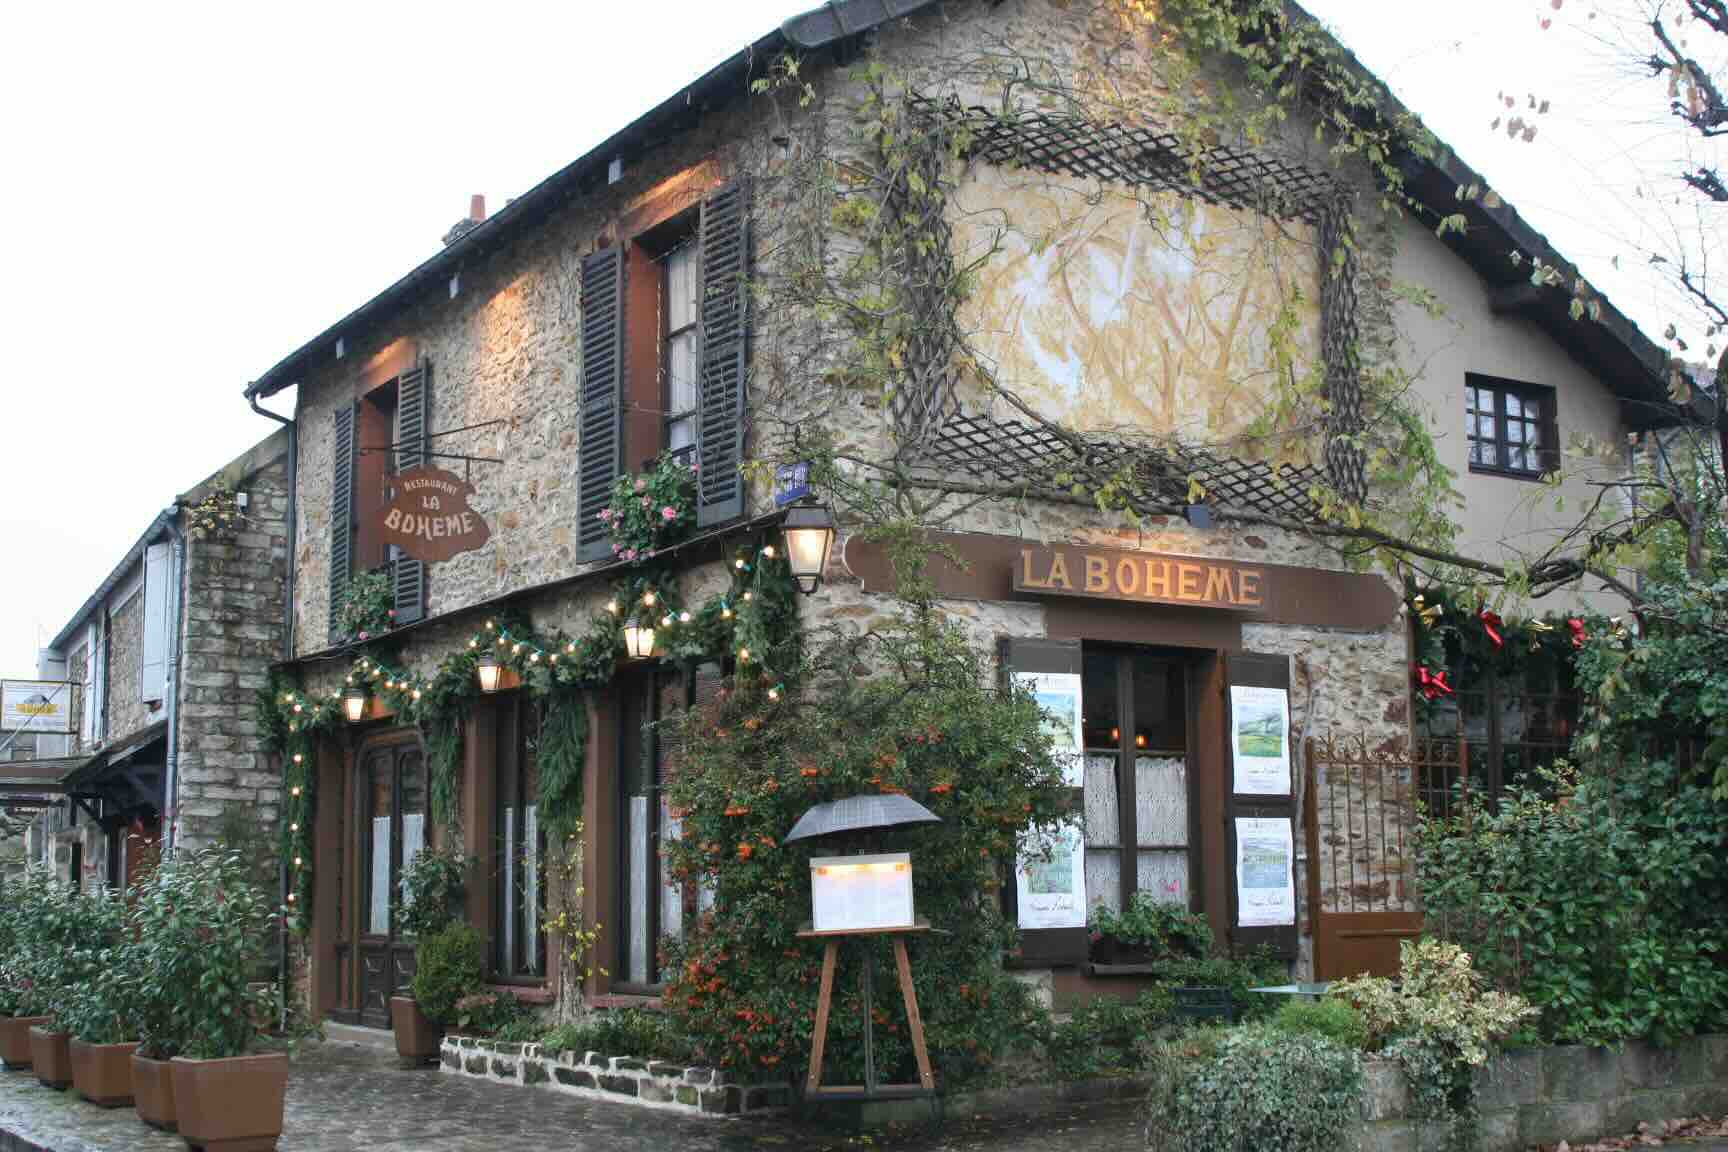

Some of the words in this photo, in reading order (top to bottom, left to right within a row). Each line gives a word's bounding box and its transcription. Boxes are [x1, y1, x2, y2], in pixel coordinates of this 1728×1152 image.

[404, 479, 458, 495] RESTAURANT
[422, 495, 441, 510] LA
[384, 508, 473, 541] BOHEME
[1021, 548, 1074, 591] LA
[1084, 554, 1263, 605] BOHEME
